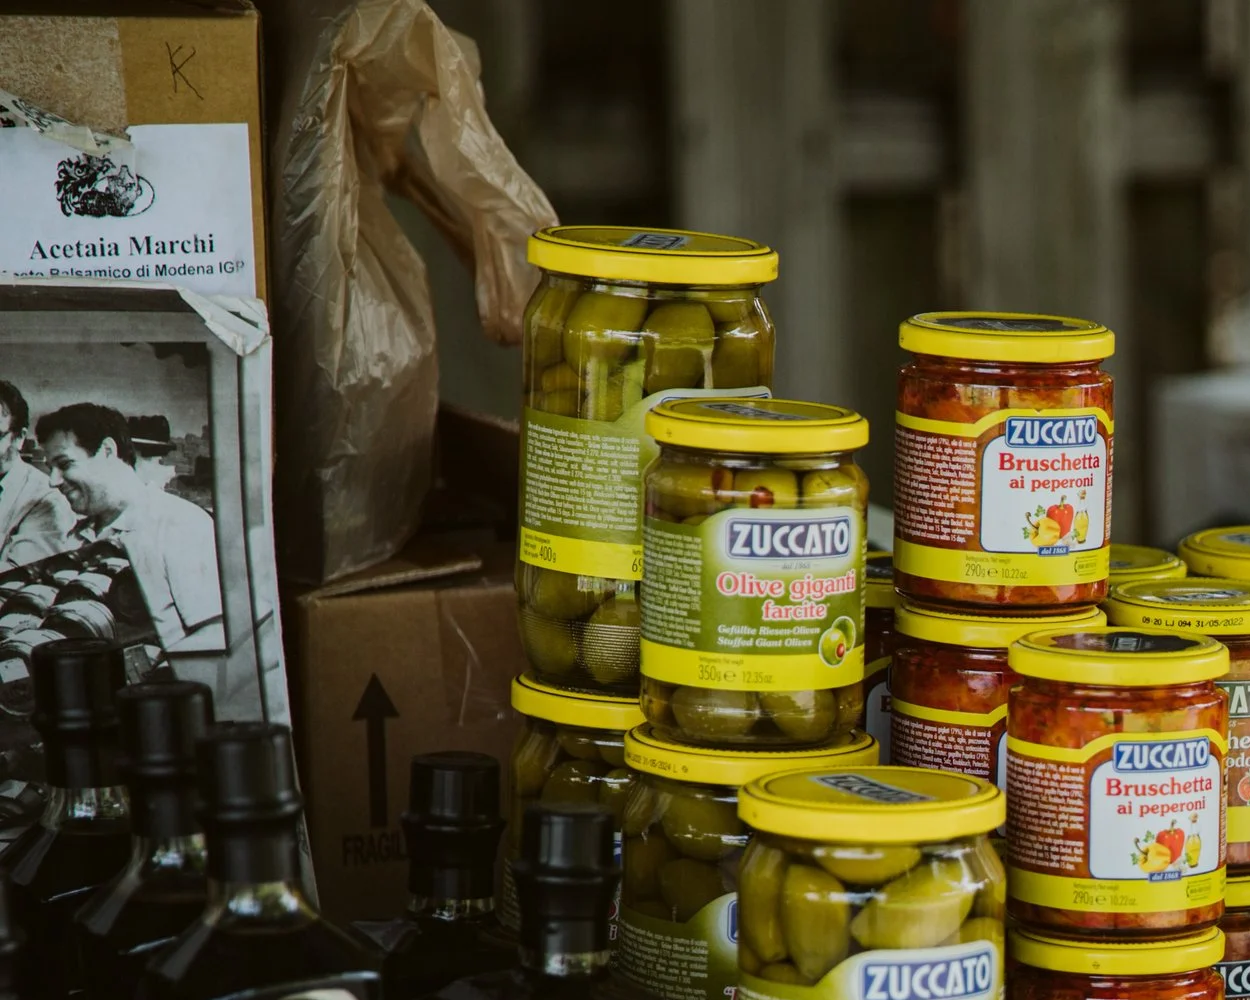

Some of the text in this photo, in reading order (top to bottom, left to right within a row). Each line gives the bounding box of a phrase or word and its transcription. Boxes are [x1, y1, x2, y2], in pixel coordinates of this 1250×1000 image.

[165, 42, 203, 100] K
[30, 234, 215, 260] Acetaia Marchi
[136, 265, 150, 278] di
[155, 263, 214, 277] Modena
[219, 260, 245, 274] IGP
[1009, 418, 1095, 445] ZUCCATO
[998, 452, 1100, 472] Bruschetta
[1009, 473, 1094, 492] ai peperoni
[731, 521, 849, 557] ZUCCATO
[965, 563, 985, 578] 290g
[717, 569, 856, 601] Olive giganti
[762, 600, 827, 620] farcite
[1178, 619, 1192, 628] 094
[1196, 617, 1244, 628] 31/05/2022
[698, 665, 721, 682] 350g
[1117, 741, 1208, 769] ZUCCATO
[1105, 776, 1212, 797] Bruschetta
[1117, 797, 1206, 817] ai peperoni
[342, 830, 407, 866] FRAGIL
[1073, 890, 1093, 906] 290g
[865, 955, 990, 1000] ZUCCATO
